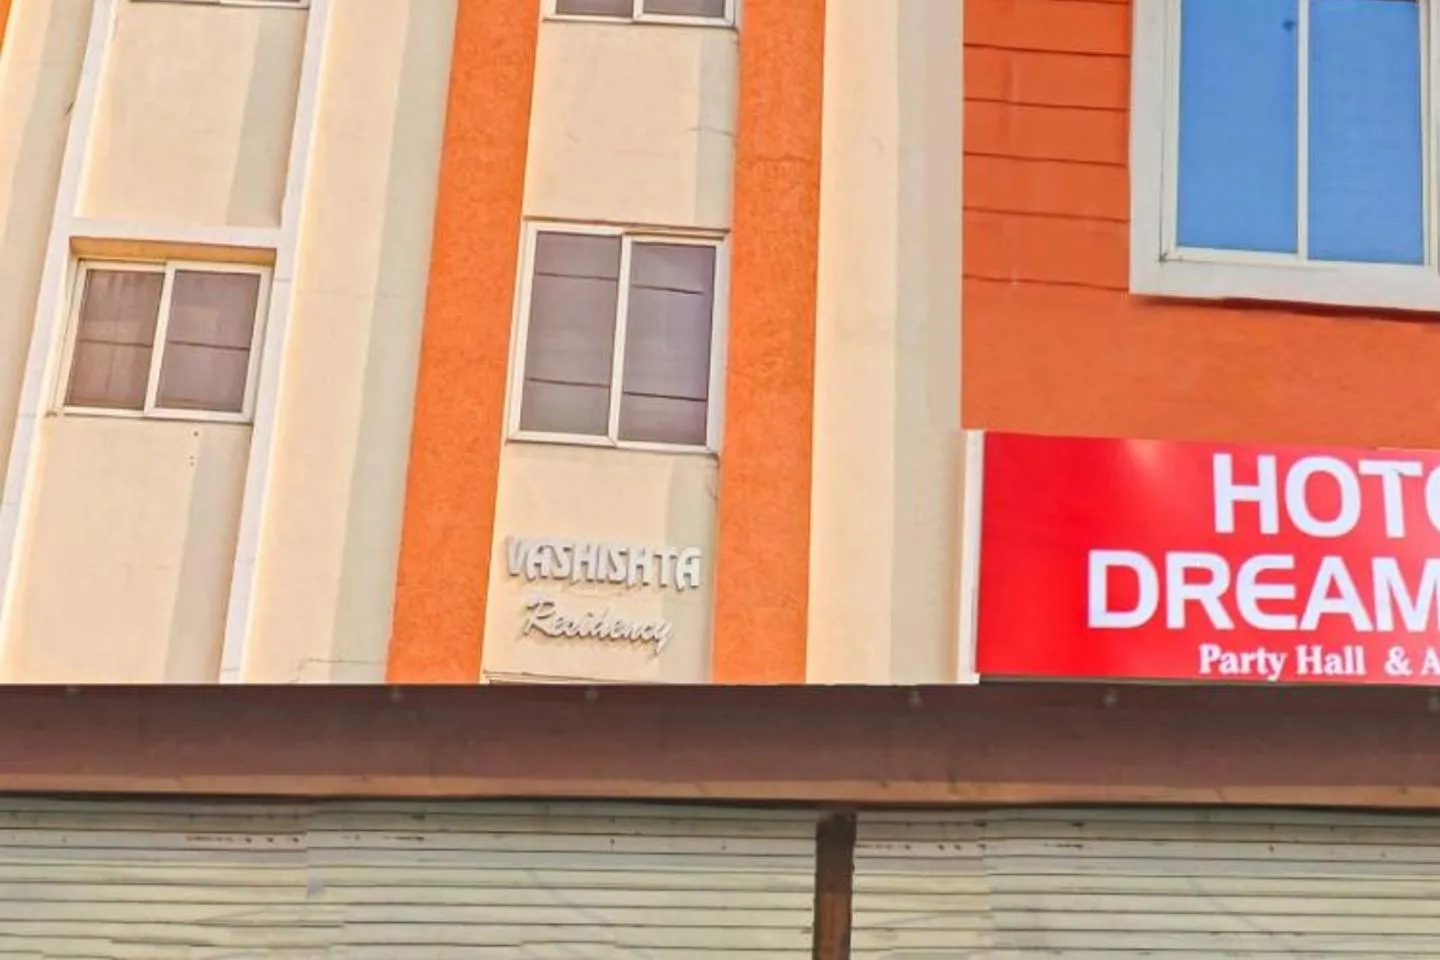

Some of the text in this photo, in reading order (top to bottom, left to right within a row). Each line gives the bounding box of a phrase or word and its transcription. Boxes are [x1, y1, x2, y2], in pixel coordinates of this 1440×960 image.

[505, 537, 702, 591] VASHISHTA
[1199, 644, 1287, 680] Party
[1296, 644, 1366, 676] Hall
[1384, 646, 1413, 677] &
